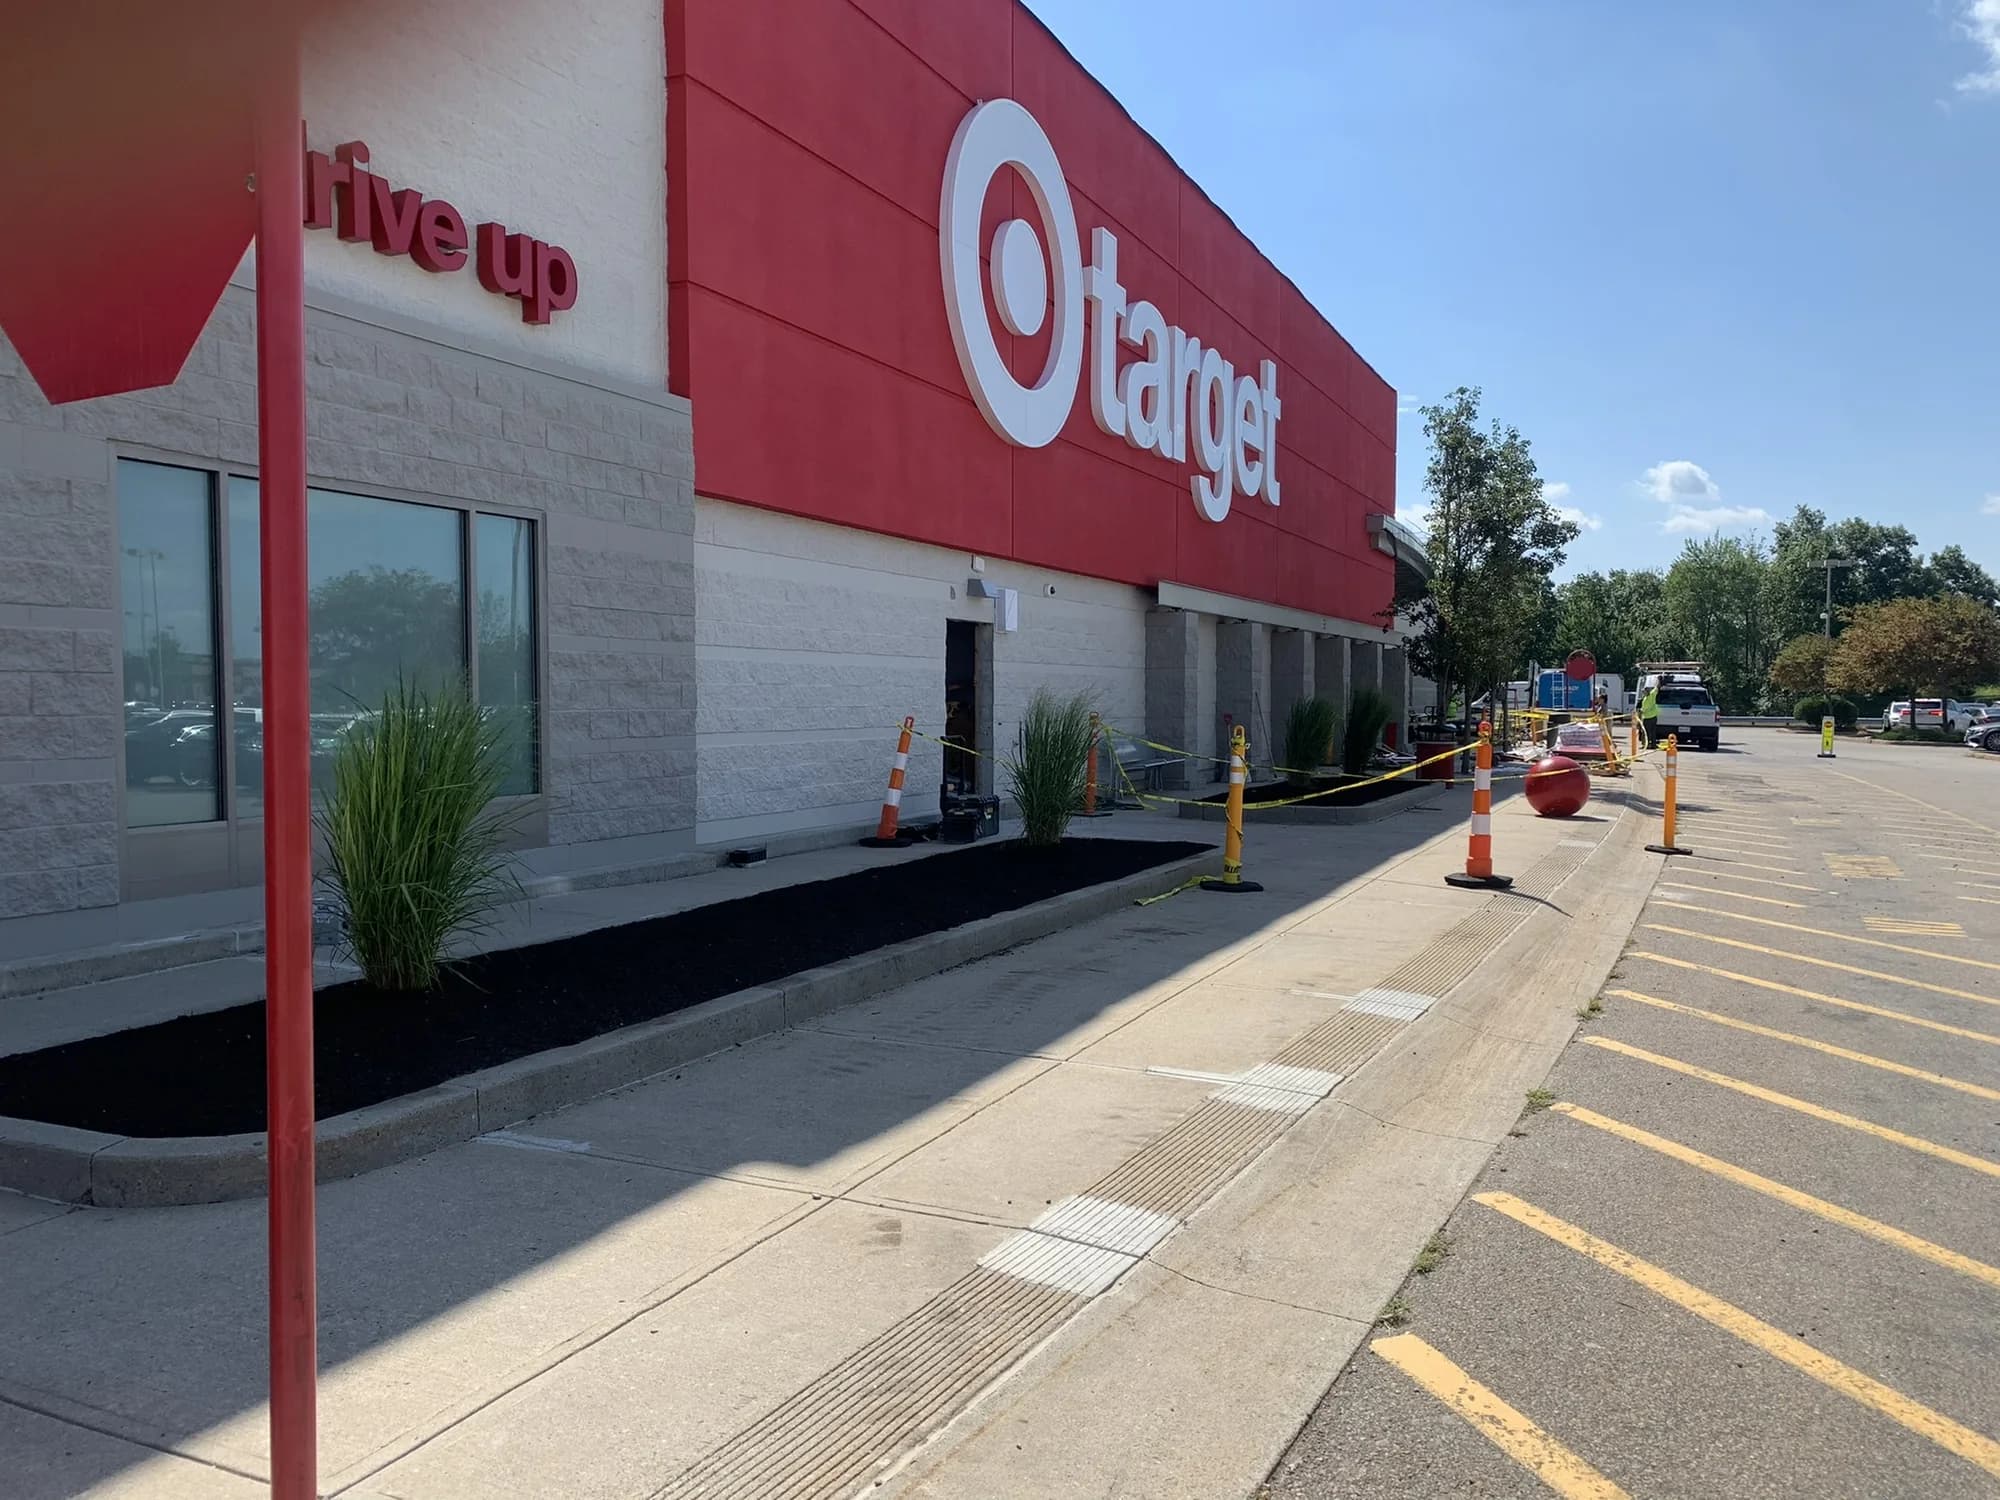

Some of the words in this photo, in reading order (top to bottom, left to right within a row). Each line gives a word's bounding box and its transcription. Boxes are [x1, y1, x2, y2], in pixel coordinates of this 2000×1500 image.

[302, 120, 468, 273] rive
[476, 222, 578, 325] up
[1083, 226, 1281, 522] target
